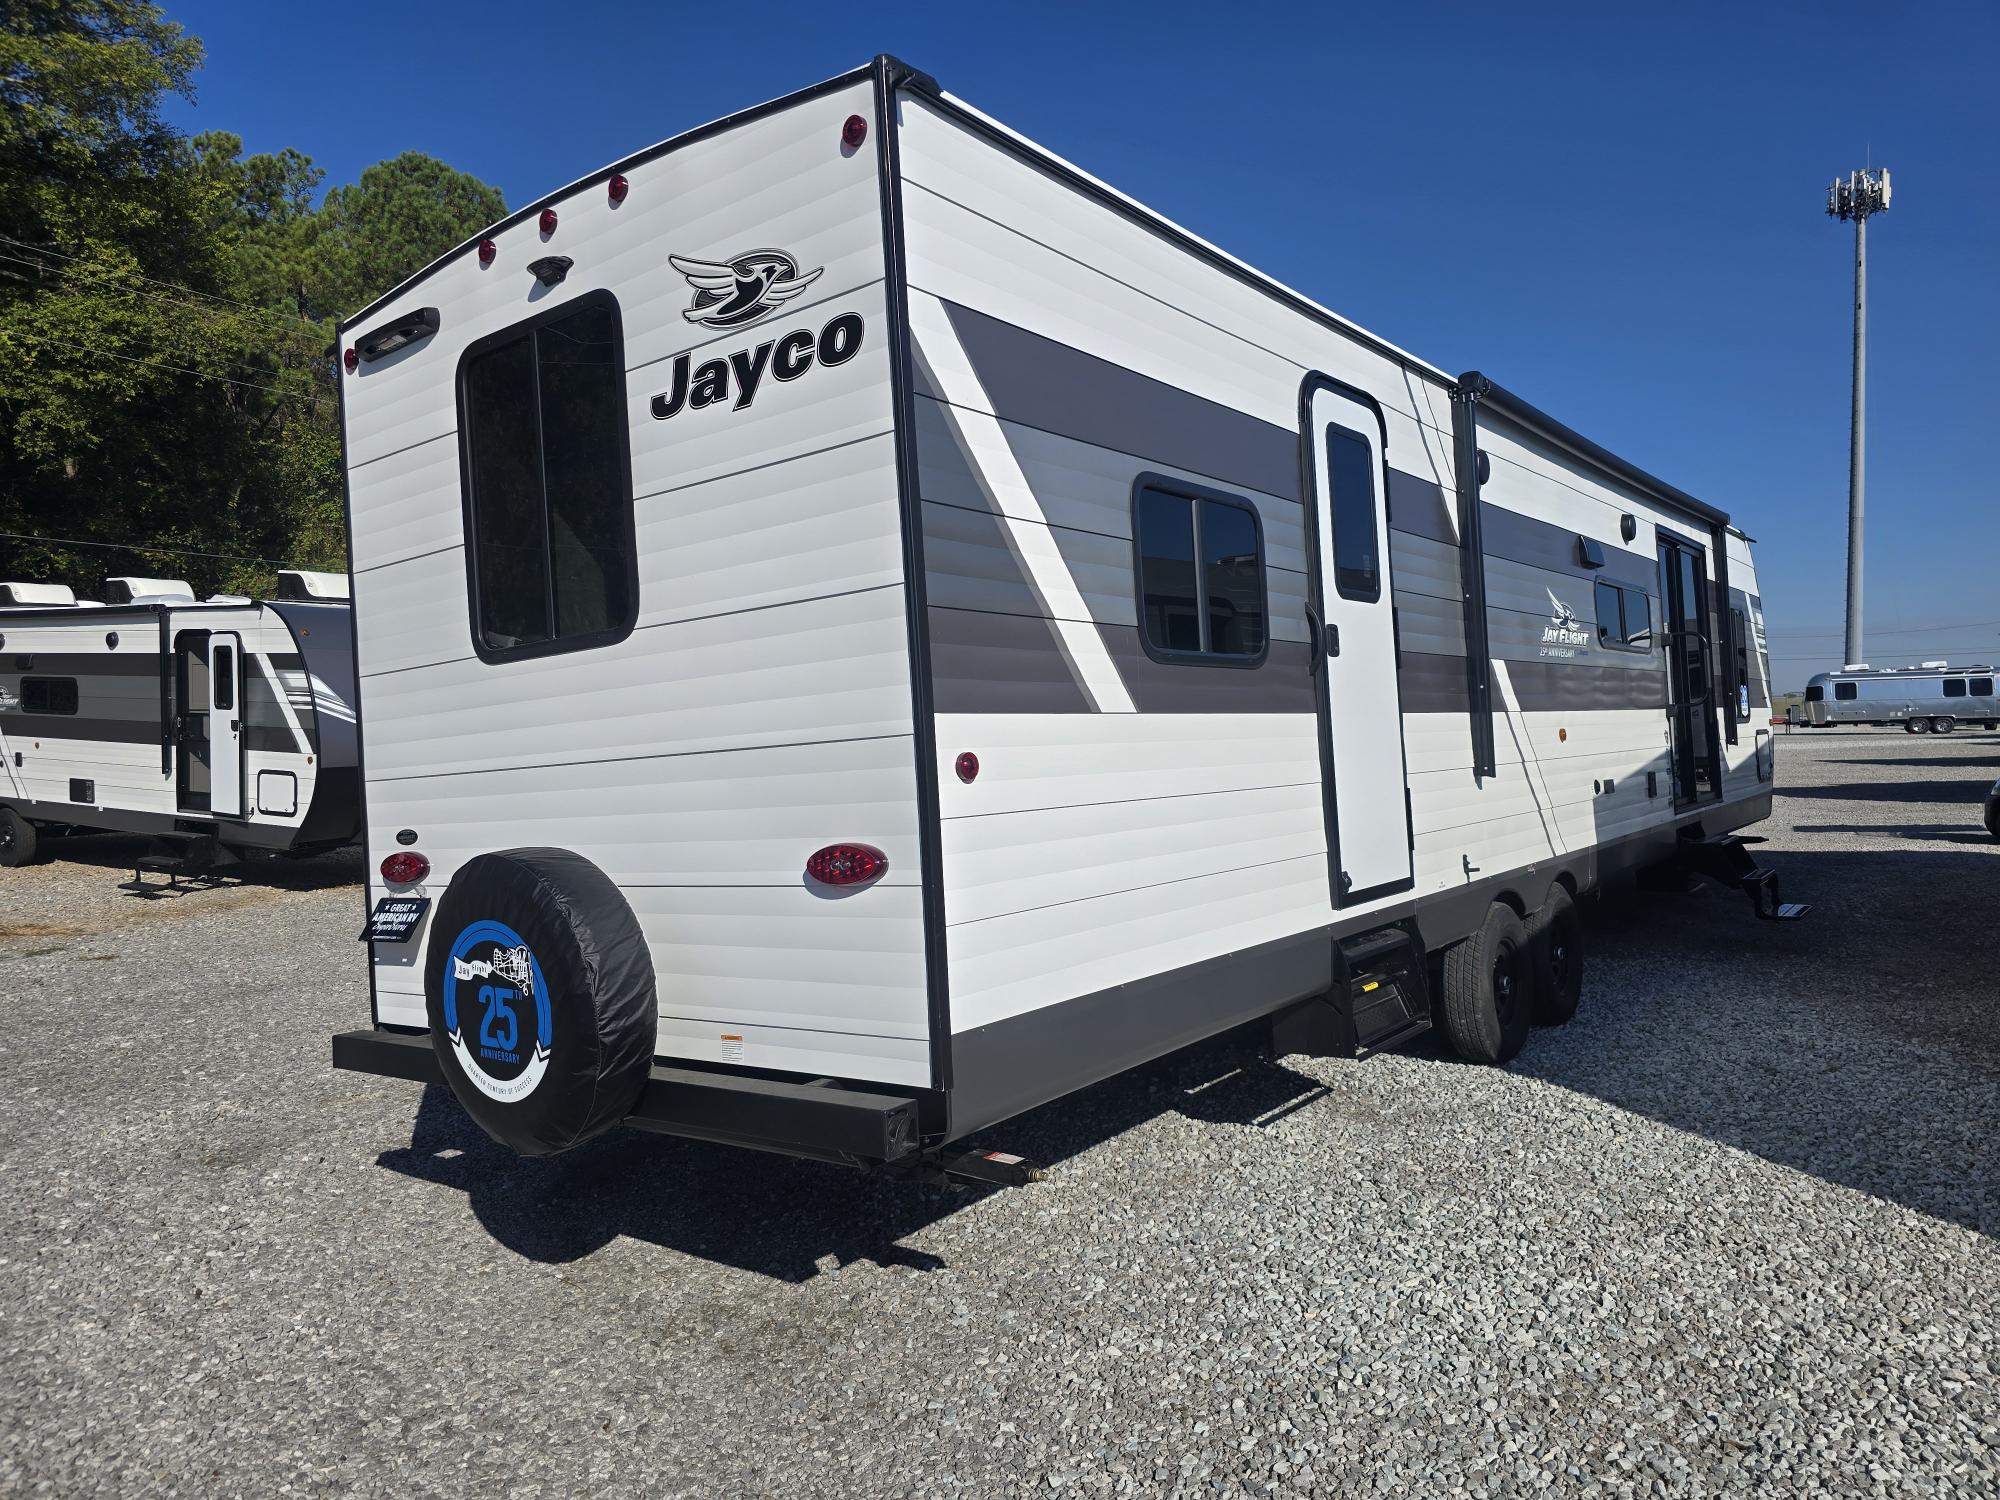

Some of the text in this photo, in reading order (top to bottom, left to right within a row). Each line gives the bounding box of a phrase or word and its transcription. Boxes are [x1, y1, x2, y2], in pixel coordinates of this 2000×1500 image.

[650, 311, 865, 421] Jayco
[1542, 626, 1589, 646] JAY FLIGHT
[390, 903, 412, 913] GREAT
[371, 912, 420, 923] AMERICAN RV
[480, 1047, 520, 1064] ANNIVERSARY
